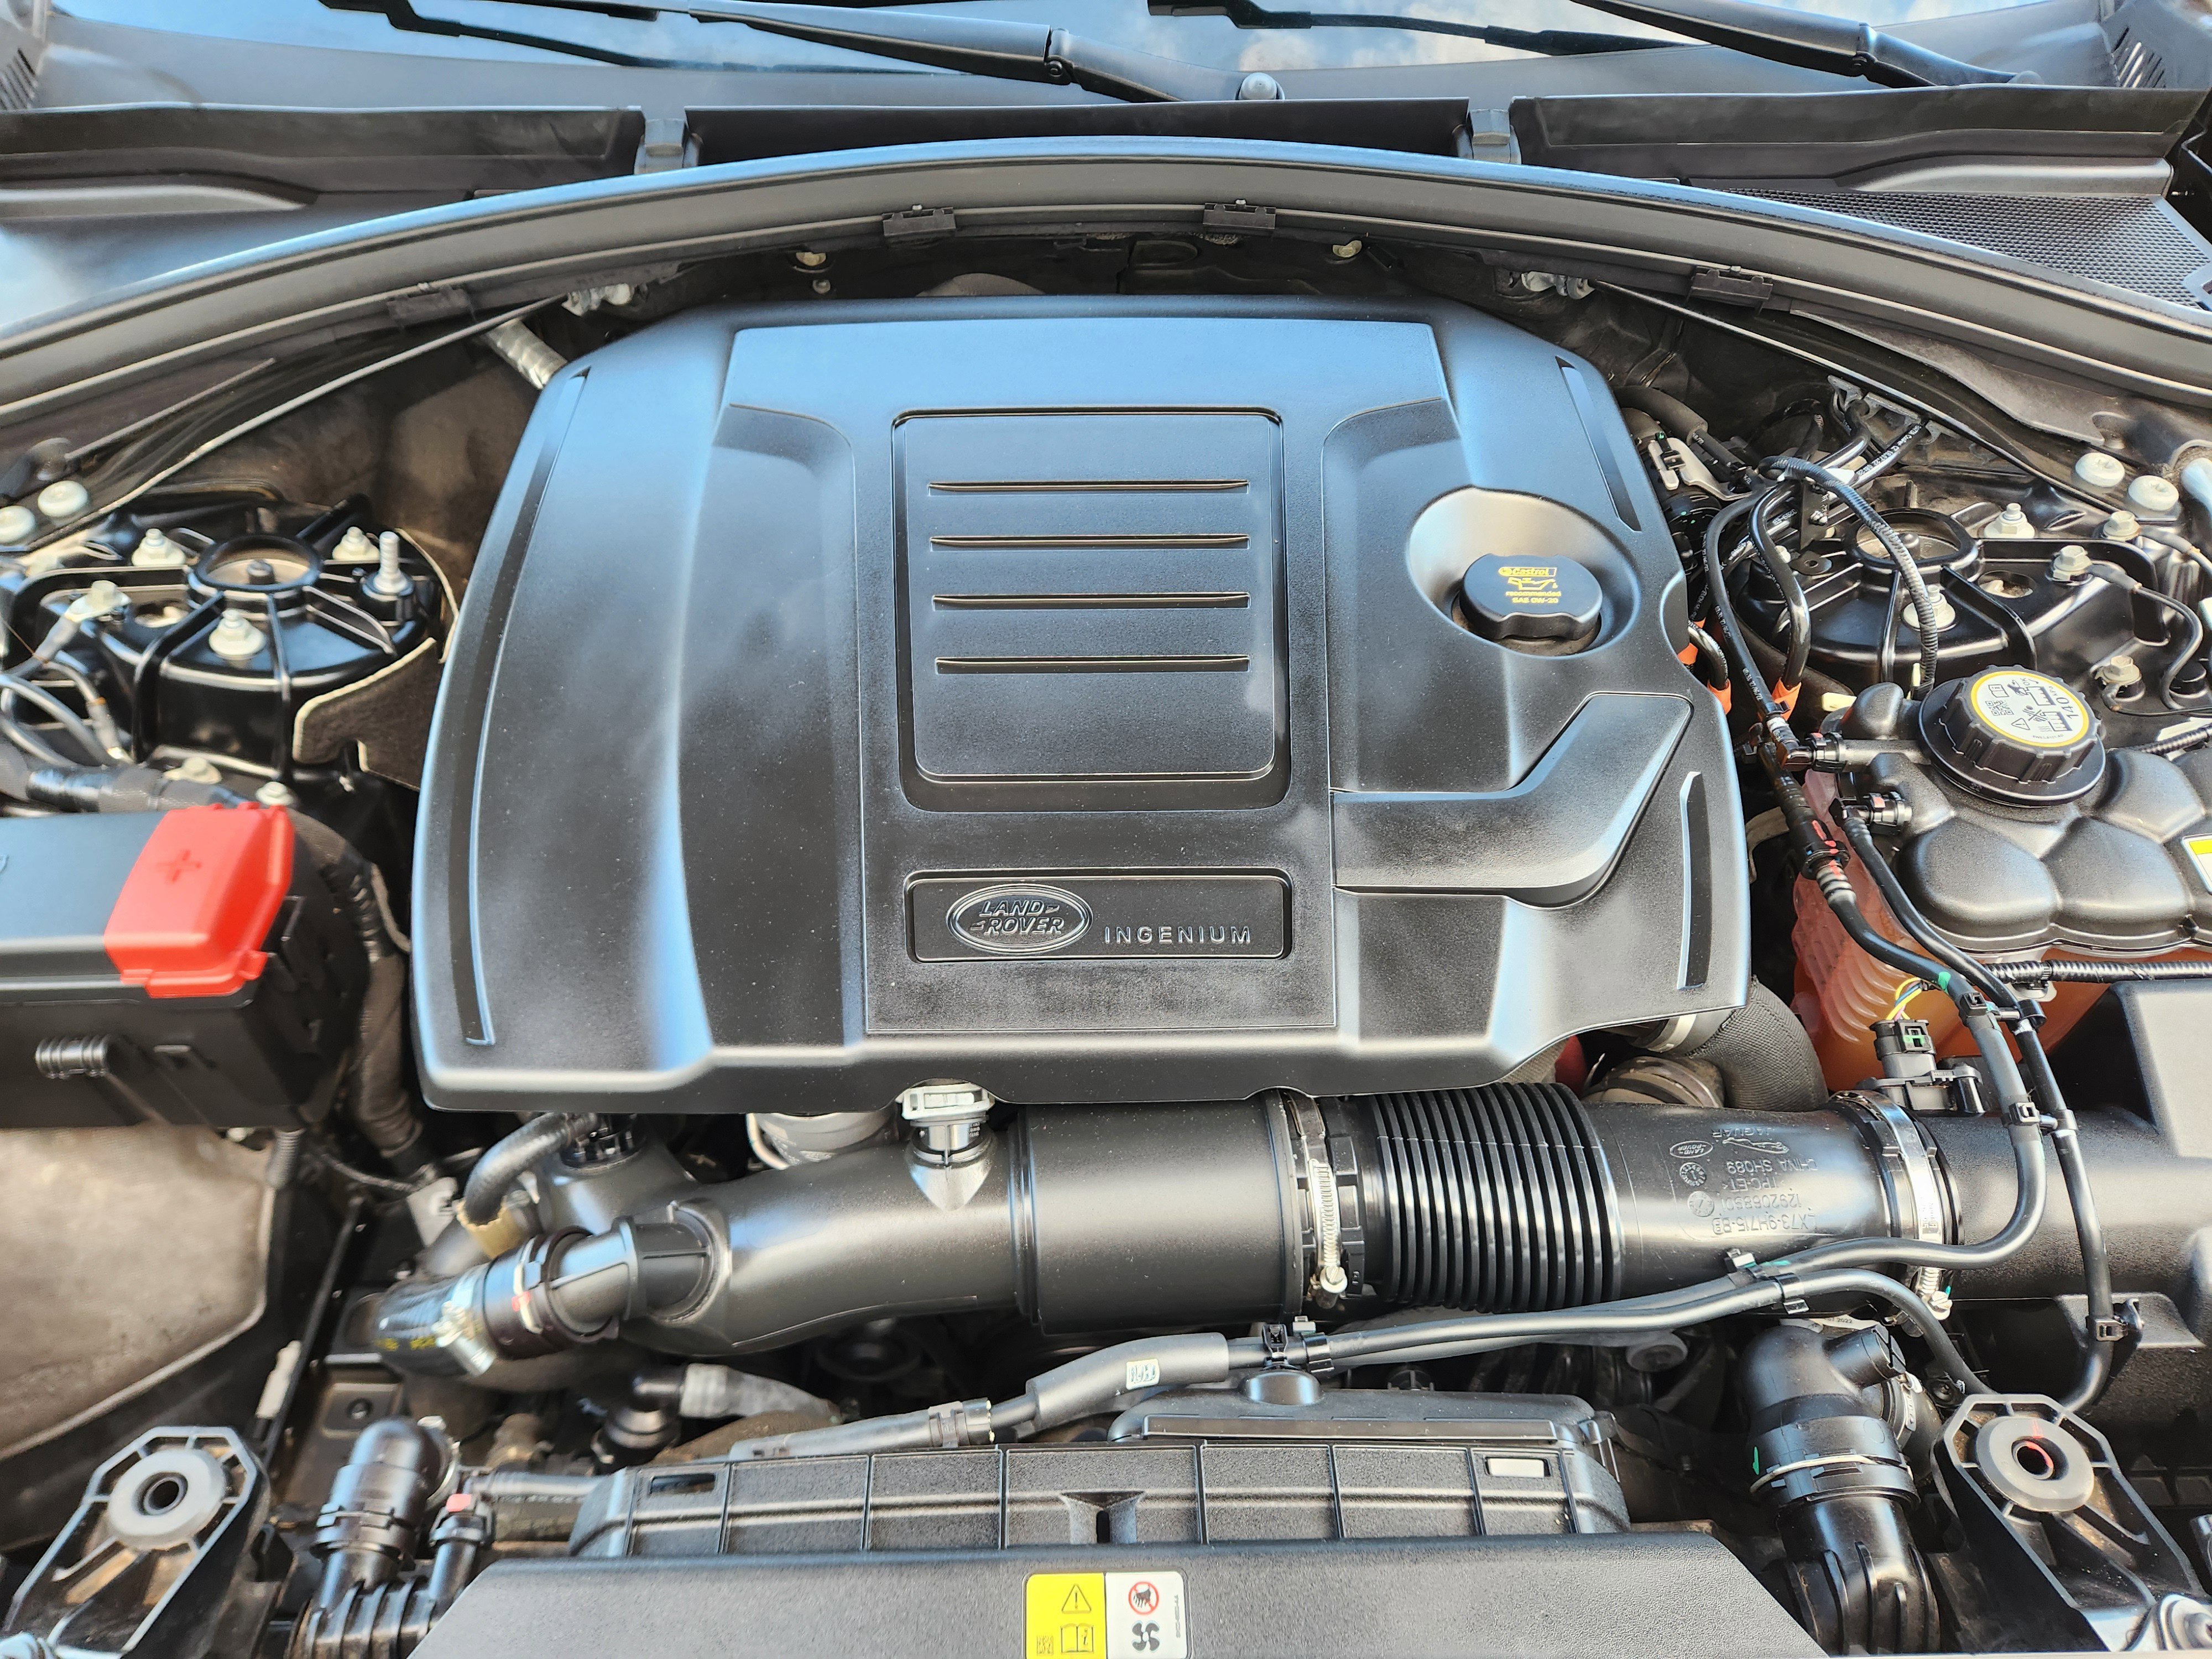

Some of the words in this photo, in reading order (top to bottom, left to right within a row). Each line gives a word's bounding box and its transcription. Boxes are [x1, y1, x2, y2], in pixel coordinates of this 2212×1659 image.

[2056, 696, 2079, 720] 140
[979, 899, 1045, 917] LAND
[984, 916, 1065, 936] ROVER
[1104, 925, 1251, 945] INGENIUM
[1711, 1126, 1772, 1138] JAGUAR
[1777, 1157, 1819, 1172] CHINA
